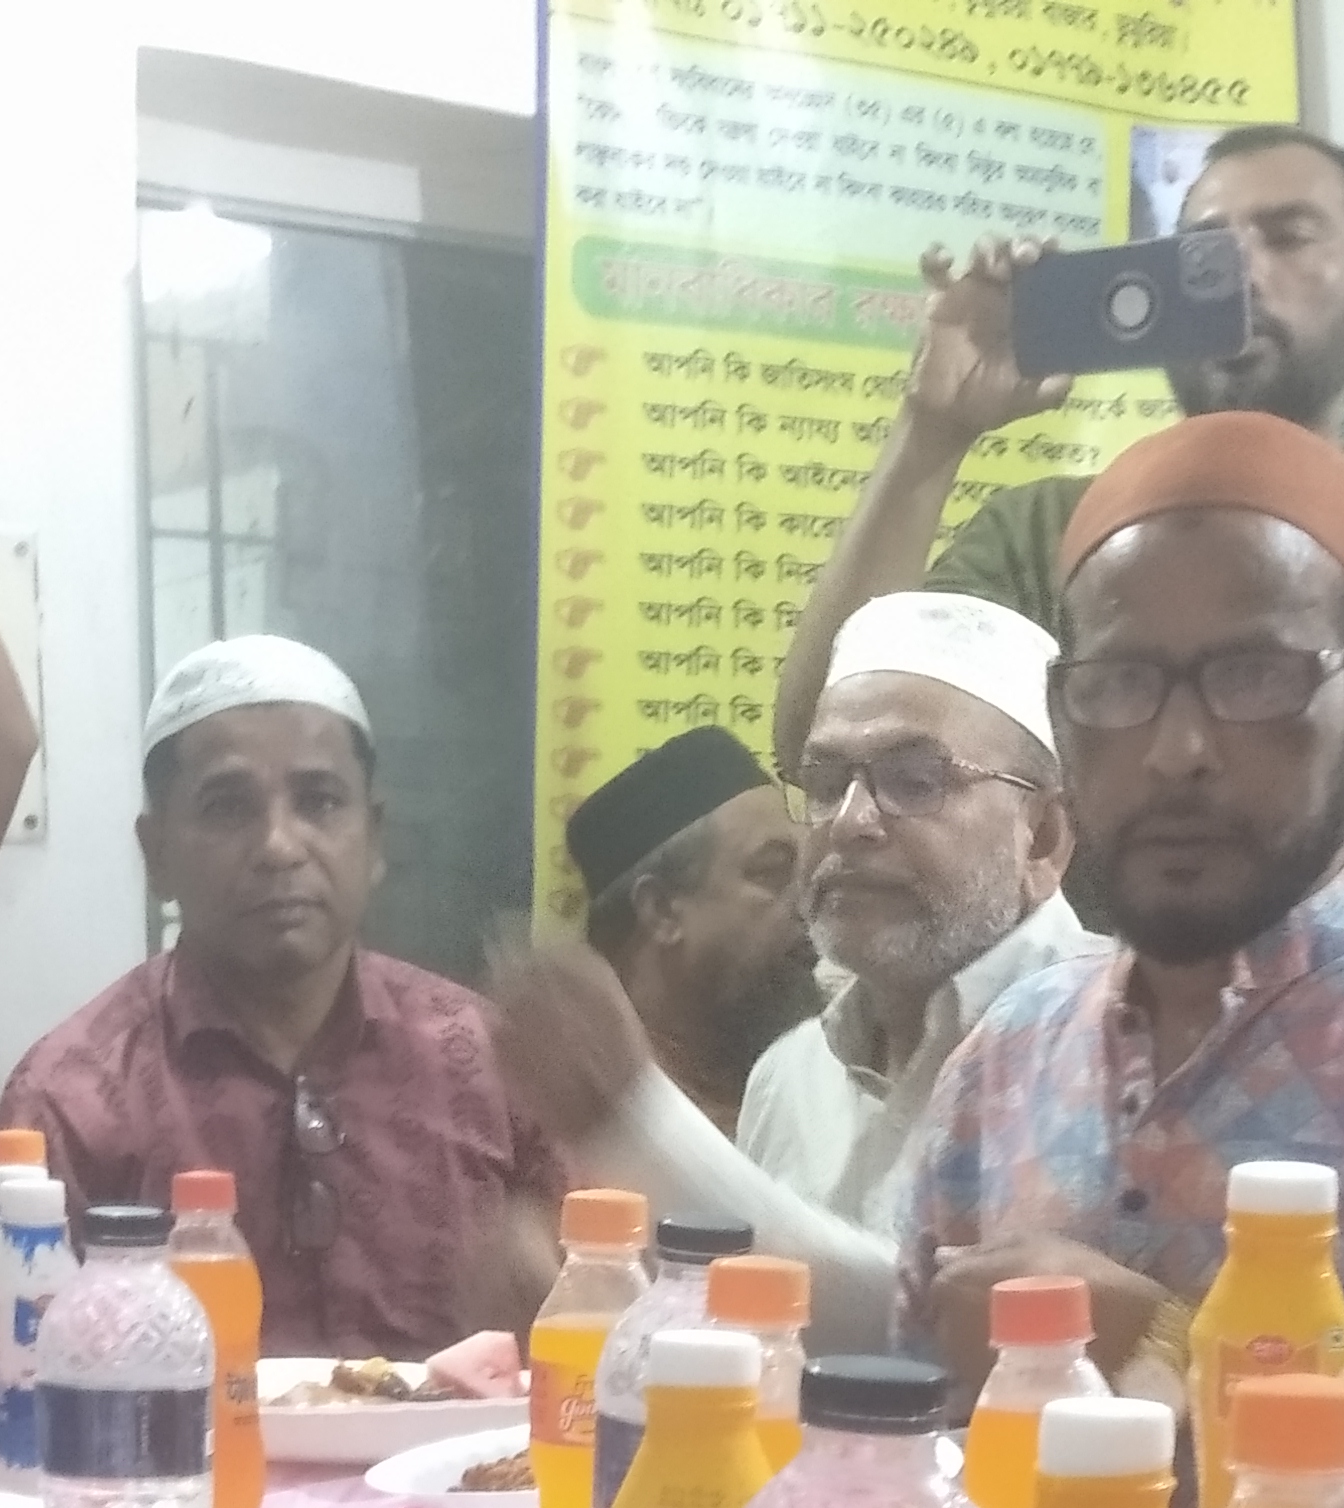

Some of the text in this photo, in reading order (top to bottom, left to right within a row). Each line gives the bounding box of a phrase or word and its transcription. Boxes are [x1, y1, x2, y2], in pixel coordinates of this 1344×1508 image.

[642, 349, 716, 382] আপনি
[722, 350, 752, 383] কি
[642, 400, 727, 430] আপনি
[735, 402, 771, 434] কি
[641, 449, 726, 479] আপনি
[734, 452, 770, 484] কি
[641, 498, 725, 530] আপনি
[734, 501, 769, 532] কি
[639, 547, 724, 581] আপনি
[733, 550, 767, 582] কি
[638, 596, 723, 629] আপনি
[732, 598, 766, 629] কি
[637, 645, 722, 677] আপনি
[730, 646, 765, 677] কি
[637, 693, 763, 724] আপনি কি
